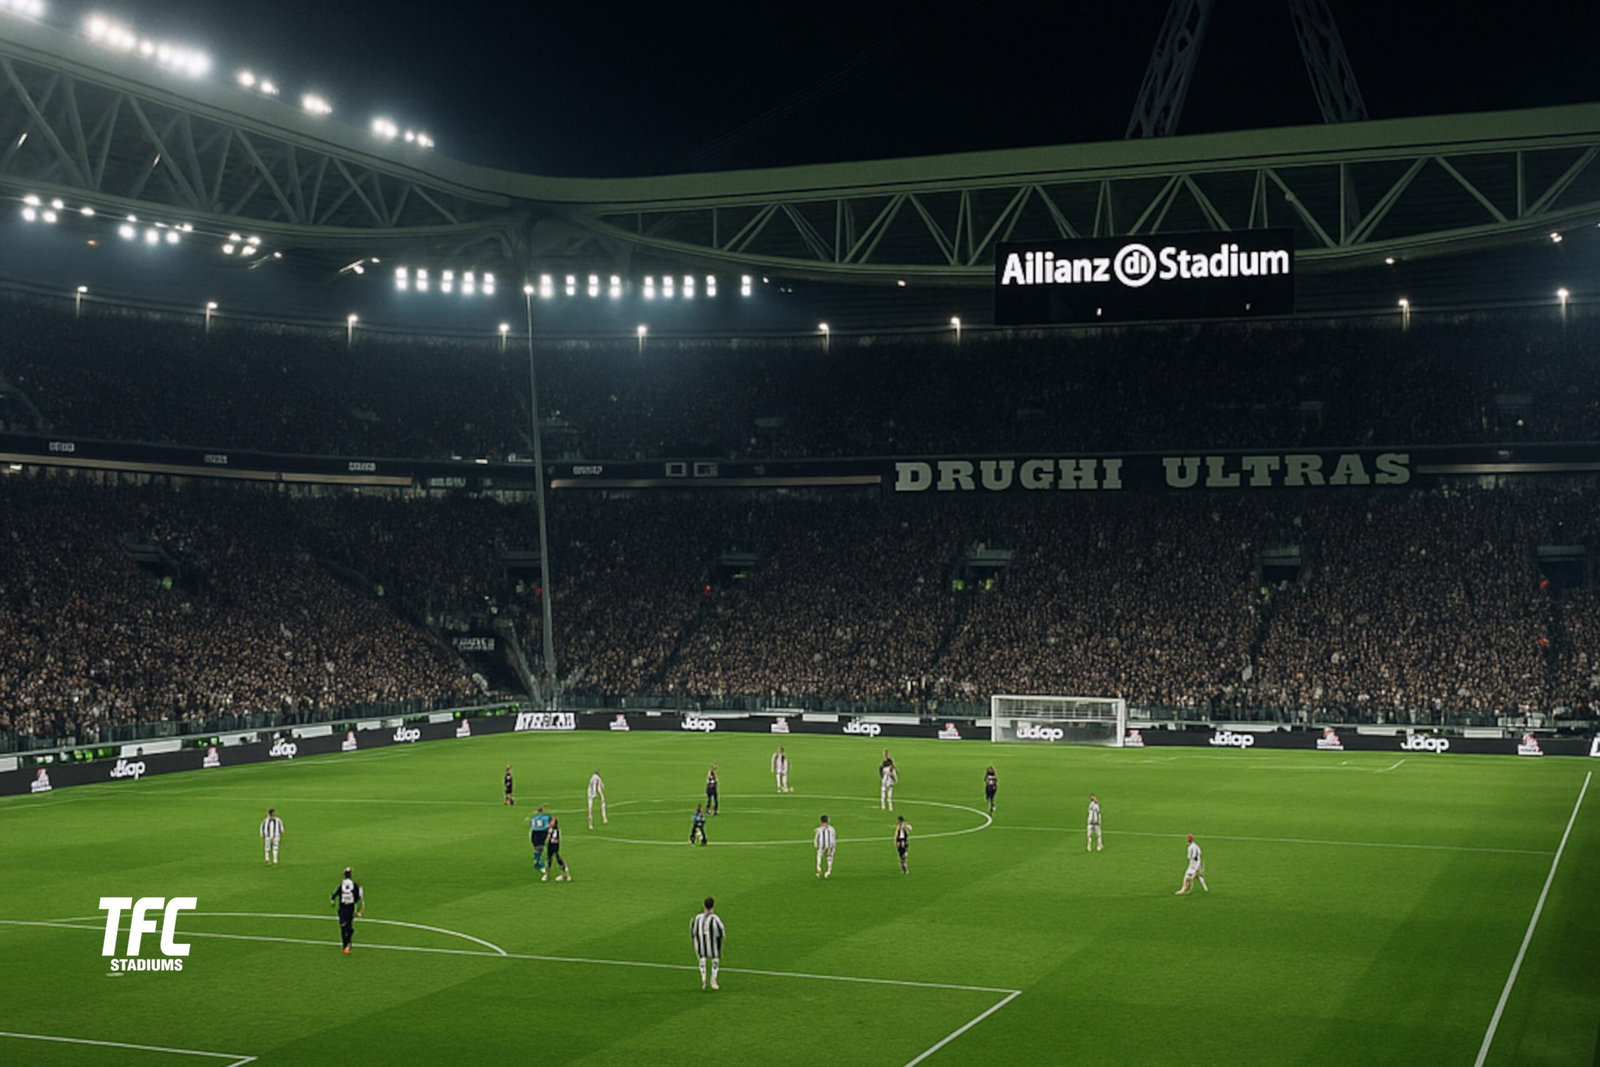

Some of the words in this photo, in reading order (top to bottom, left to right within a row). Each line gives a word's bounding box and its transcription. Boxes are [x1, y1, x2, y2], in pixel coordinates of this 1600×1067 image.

[1159, 243, 1289, 279] Stadium
[895, 459, 1122, 491] DRUGHI
[1162, 453, 1410, 487] ULTRAS
